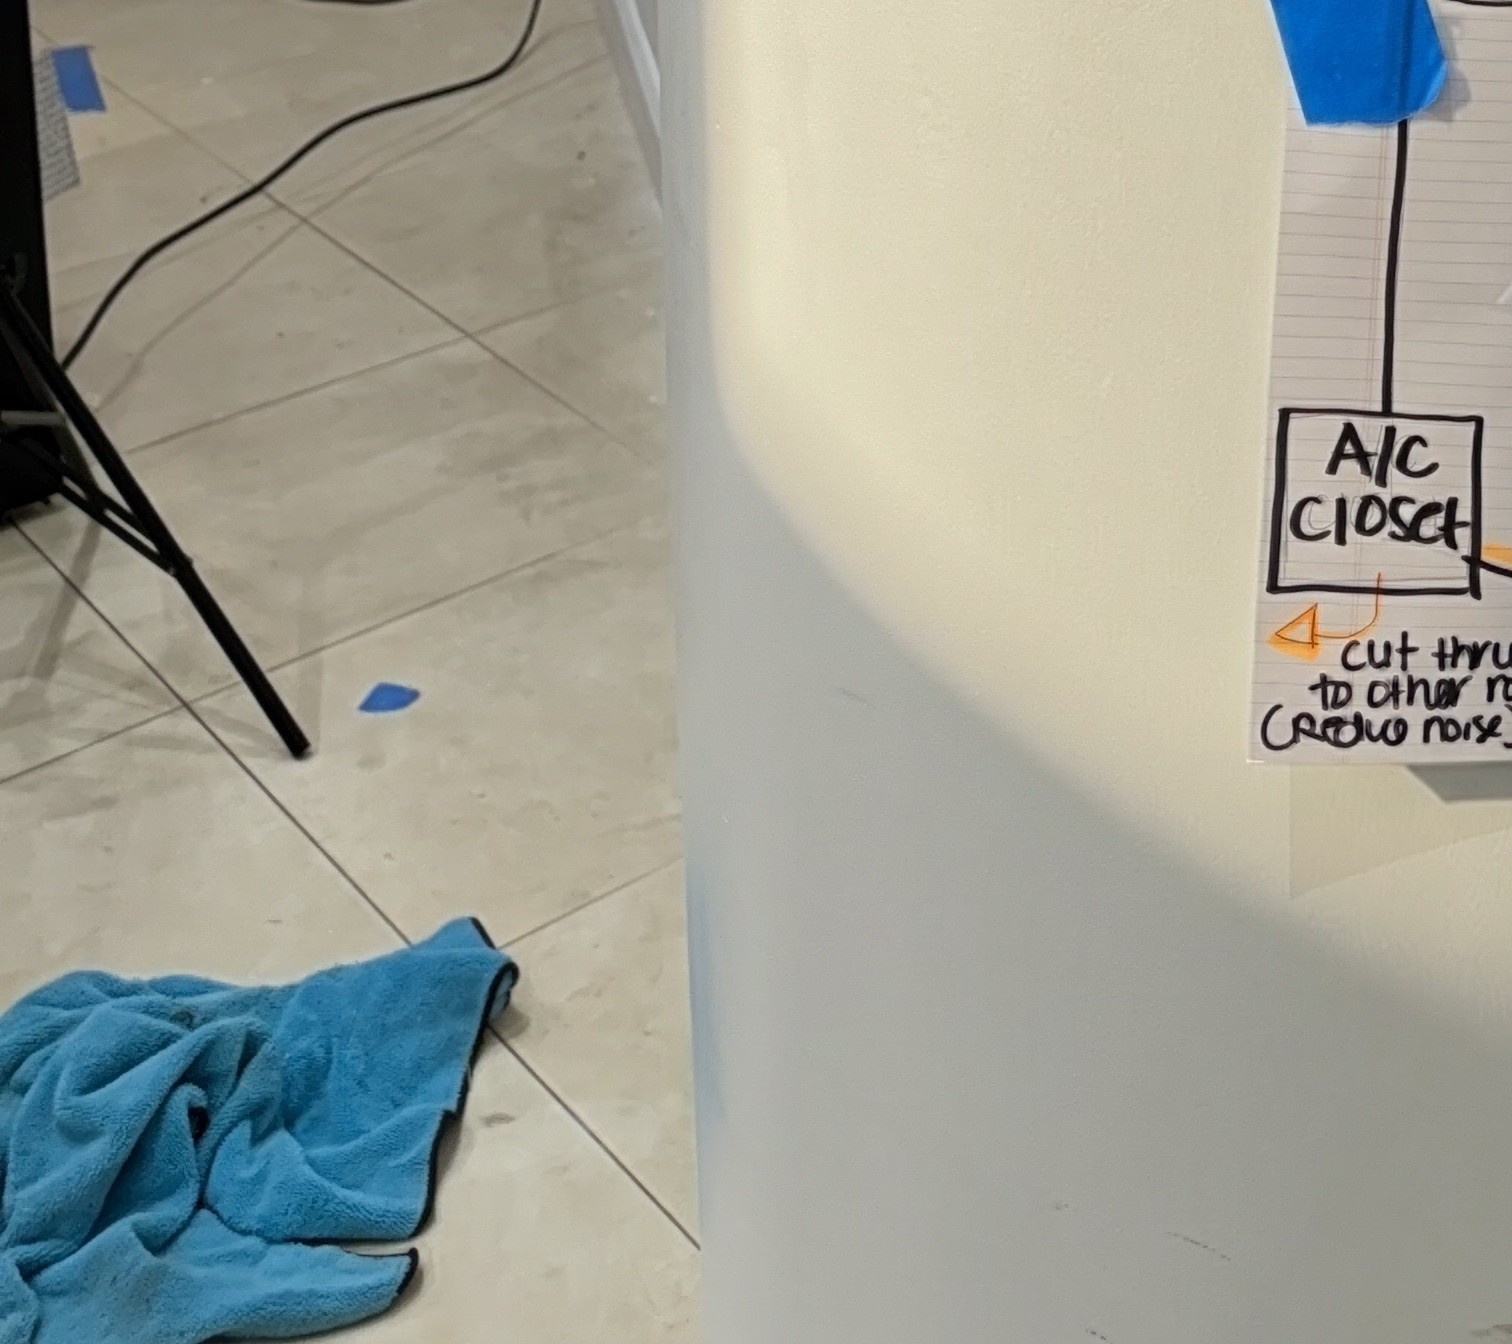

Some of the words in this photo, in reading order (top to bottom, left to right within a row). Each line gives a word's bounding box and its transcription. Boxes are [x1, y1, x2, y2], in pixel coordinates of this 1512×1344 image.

[1325, 422, 1439, 488] A/C
[1341, 631, 1419, 671] cut
[1308, 673, 1351, 710] to
[1368, 674, 1472, 710] other
